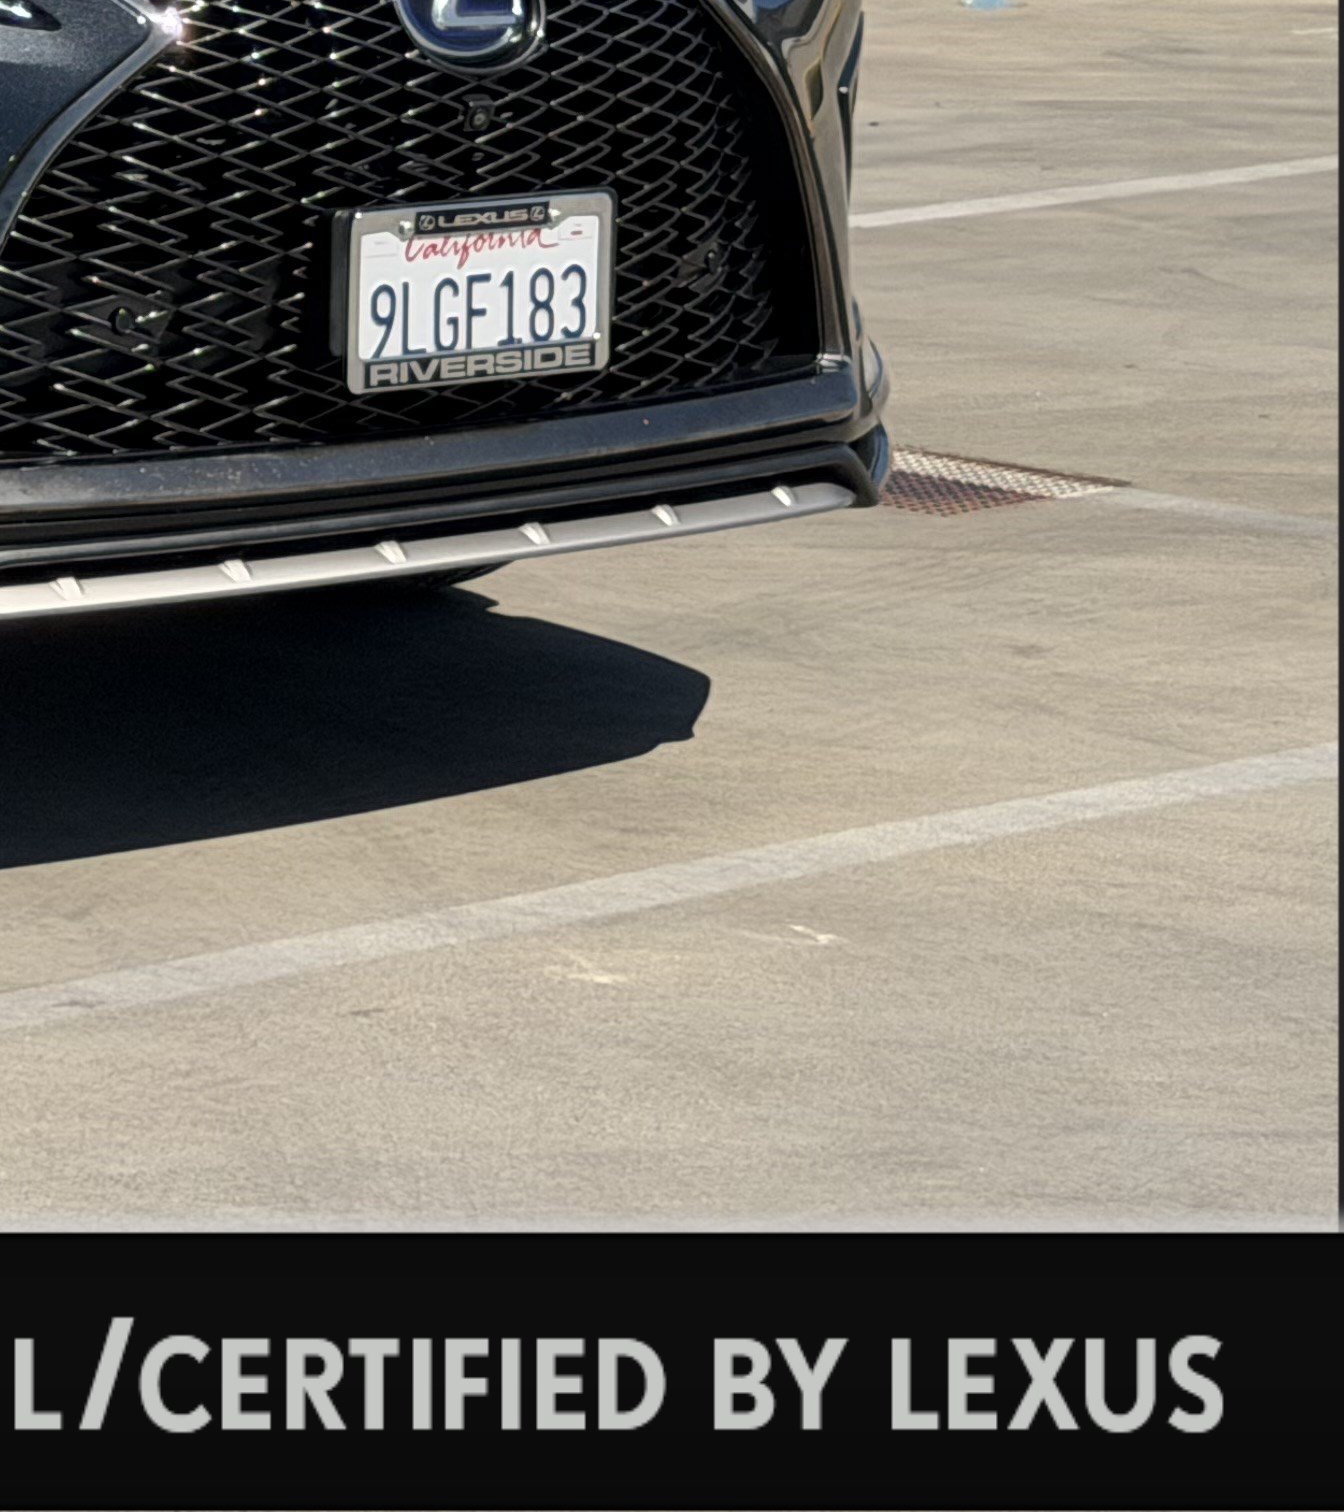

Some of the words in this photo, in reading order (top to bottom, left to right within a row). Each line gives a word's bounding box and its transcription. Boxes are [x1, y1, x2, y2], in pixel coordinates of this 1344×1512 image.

[437, 207, 530, 229] LEXUS
[404, 228, 560, 270] California
[370, 263, 588, 360] 9LGF183
[369, 342, 593, 387] RIVERSIDE
